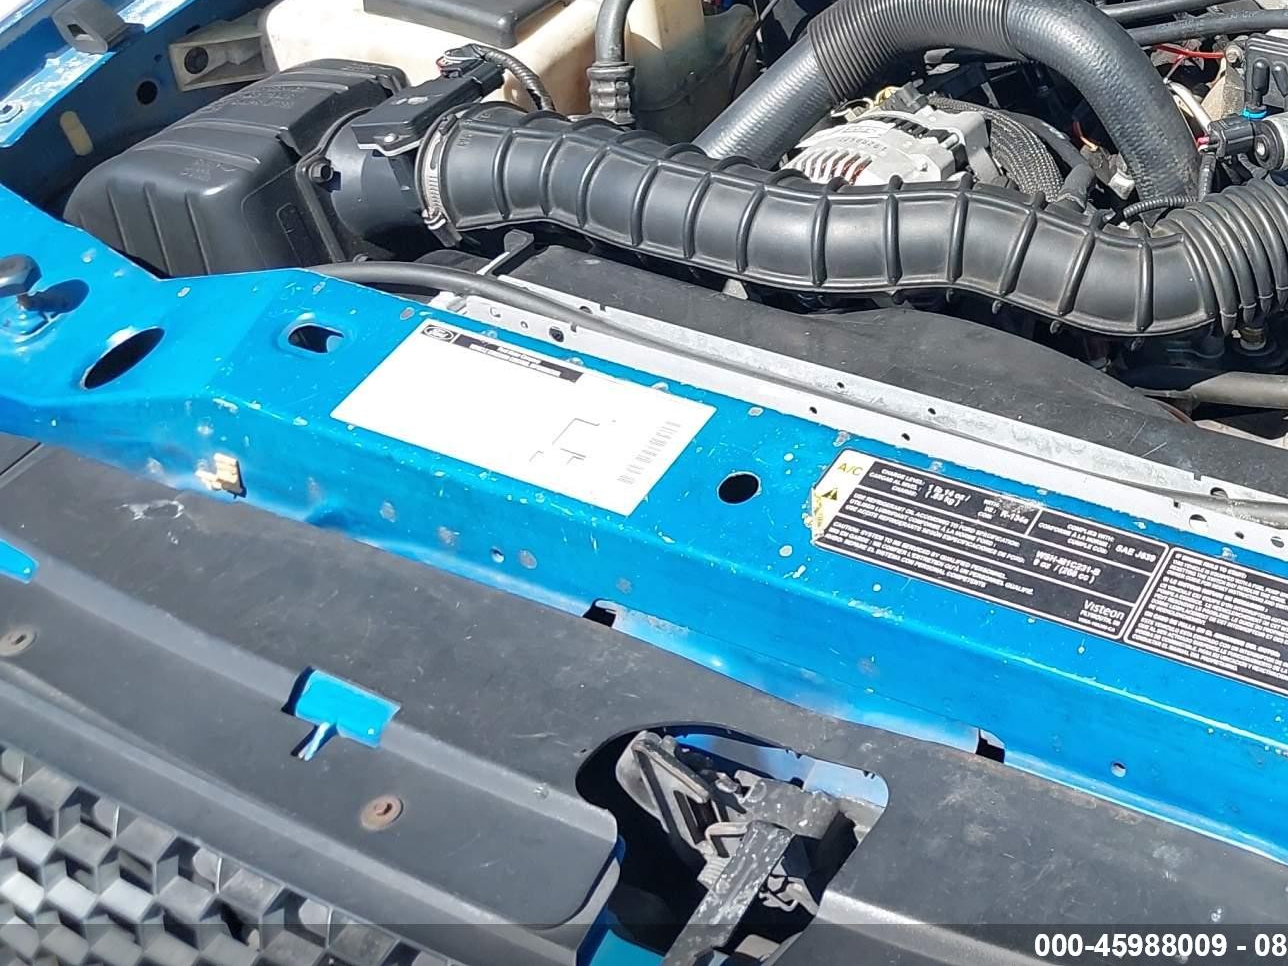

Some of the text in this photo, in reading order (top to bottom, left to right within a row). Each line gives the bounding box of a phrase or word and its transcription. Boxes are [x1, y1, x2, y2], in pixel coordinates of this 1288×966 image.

[837, 461, 863, 476] A/C
[1113, 544, 1135, 556] SAE
[1081, 599, 1126, 621] Visteon
